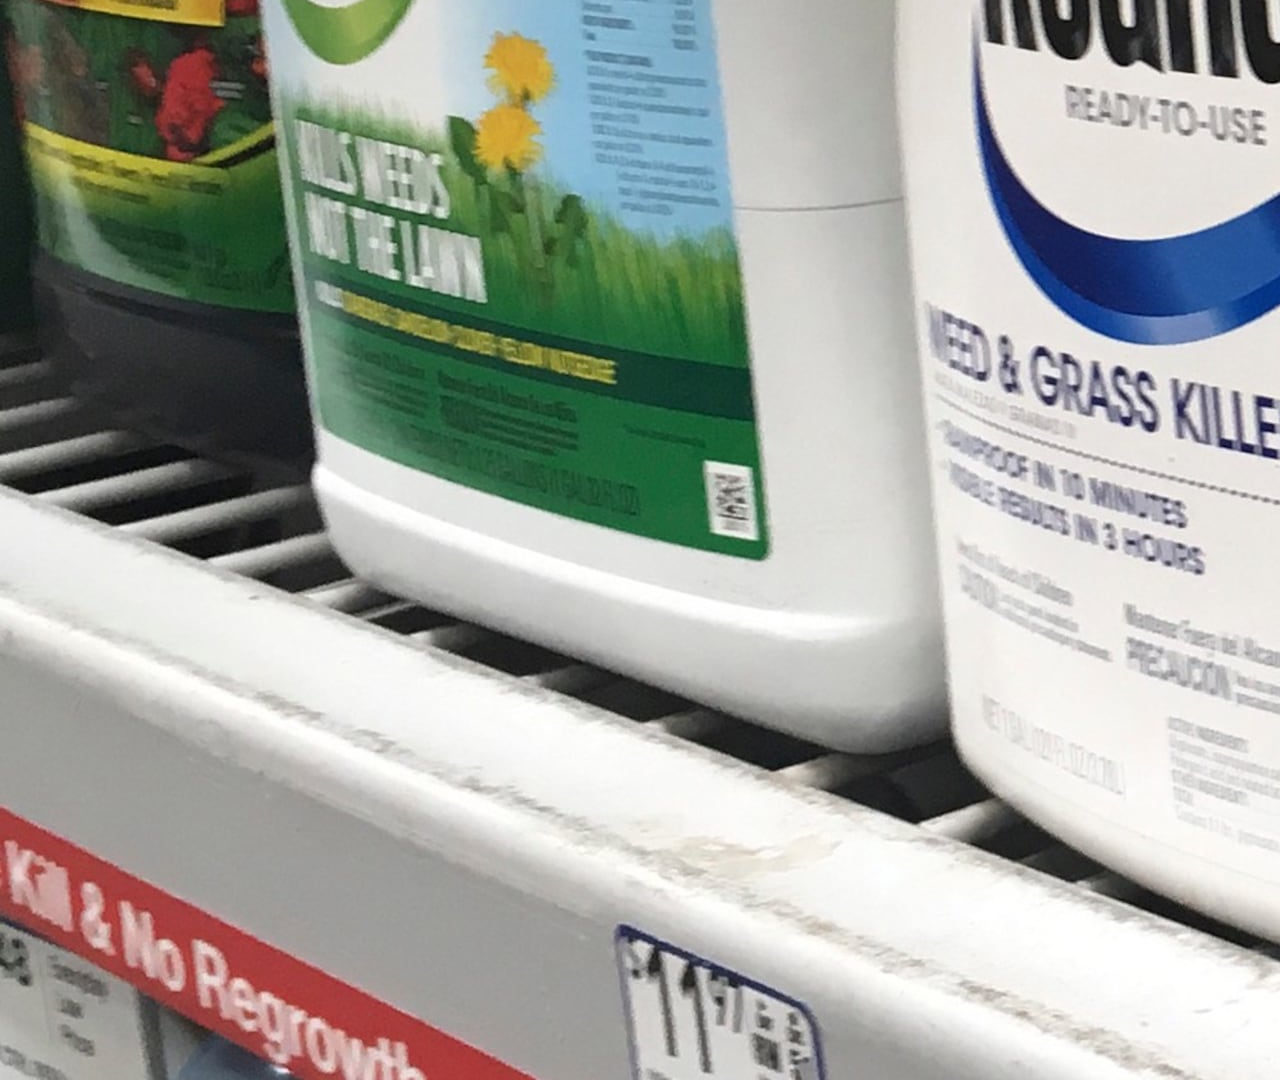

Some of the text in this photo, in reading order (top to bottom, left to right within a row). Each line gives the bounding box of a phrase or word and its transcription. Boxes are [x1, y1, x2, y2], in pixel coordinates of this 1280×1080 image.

[1064, 84, 1268, 147] READY-TO-USE
[997, 333, 1023, 395] &
[1029, 345, 1162, 434] GRASS
[1121, 527, 1207, 577] HOURS
[79, 881, 117, 957] &
[118, 899, 187, 993] No
[191, 937, 431, 1080] Regrowth
